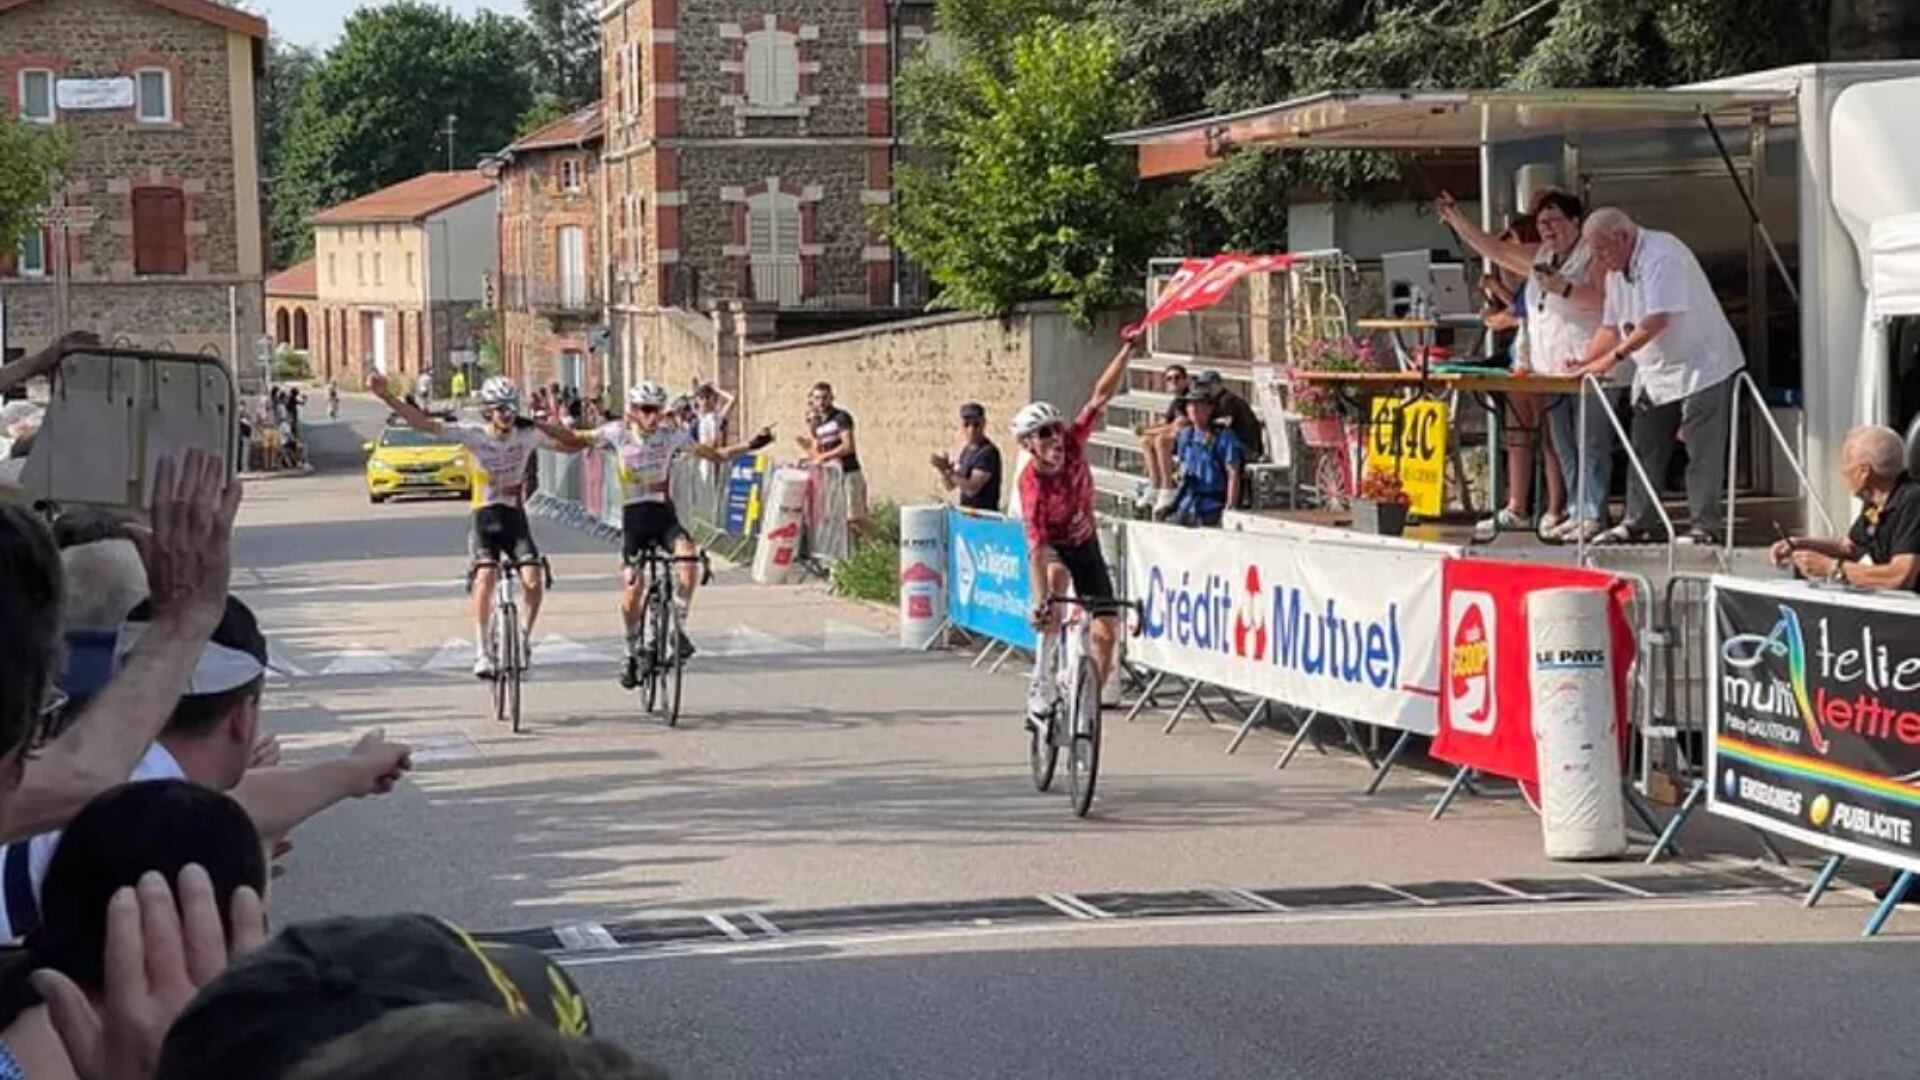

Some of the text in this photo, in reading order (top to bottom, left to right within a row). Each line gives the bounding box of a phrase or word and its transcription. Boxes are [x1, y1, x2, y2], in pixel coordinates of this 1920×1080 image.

[1143, 566, 1399, 690] Crédit Mutuel
[1536, 649, 1605, 663] LE PAYS
[1832, 802, 1912, 845] PUBLICITE
